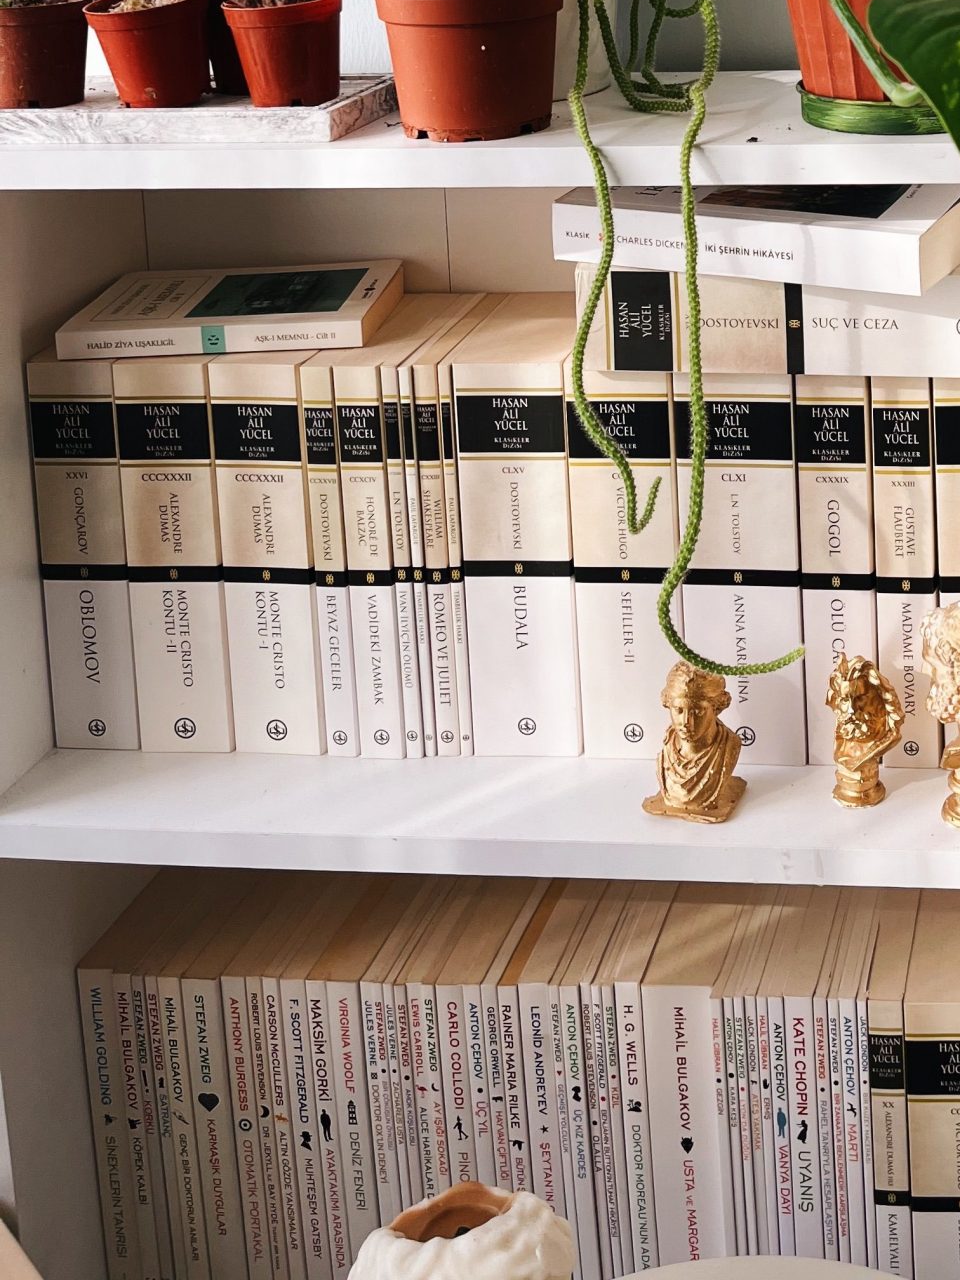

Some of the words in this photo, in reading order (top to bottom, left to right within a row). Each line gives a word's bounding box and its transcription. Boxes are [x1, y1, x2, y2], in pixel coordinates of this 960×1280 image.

[565, 230, 590, 239] KLASİK
[616, 235, 653, 246] CHARLES
[705, 243, 717, 253] İKİ
[720, 244, 753, 256] ŞEHRİN
[754, 247, 793, 260] HİKÂYESİ
[87, 341, 113, 349] HALİD
[114, 340, 133, 348] ZİYA
[812, 317, 839, 332] SUÇ
[843, 317, 864, 331] VE
[864, 317, 899, 331] CEZA
[238, 406, 272, 417] HASAN
[240, 427, 272, 439] YÜCEL
[142, 473, 192, 482] CCCXXXII
[72, 487, 88, 555] GONÇAROV
[826, 499, 843, 558] GOGOL
[162, 589, 176, 636] KONTU
[177, 589, 191, 637] MONTE
[513, 585, 528, 651] BUDALA
[901, 602, 916, 662] MADAME
[79, 590, 100, 684] OBLOMOV
[180, 639, 194, 688] CRISTO
[903, 665, 916, 718] BOVARY
[194, 995, 209, 1044] STEFAN
[310, 999, 329, 1055] MAKSİM
[624, 1005, 633, 1021] H.
[625, 1024, 634, 1039] G.
[674, 1006, 686, 1054] MİHAİL
[792, 1018, 805, 1056] KATE
[198, 1046, 211, 1083] ZWEIG
[316, 1059, 332, 1101] GORKİ
[626, 1041, 638, 1086] WELLS
[678, 1058, 690, 1131] BULGAKOV
[794, 1059, 808, 1116] CHOPIN
[683, 1160, 694, 1192] USTA
[778, 1144, 789, 1183] VANYA
[798, 1151, 814, 1212] UYANIŞ
[780, 1186, 791, 1214] DAYI
